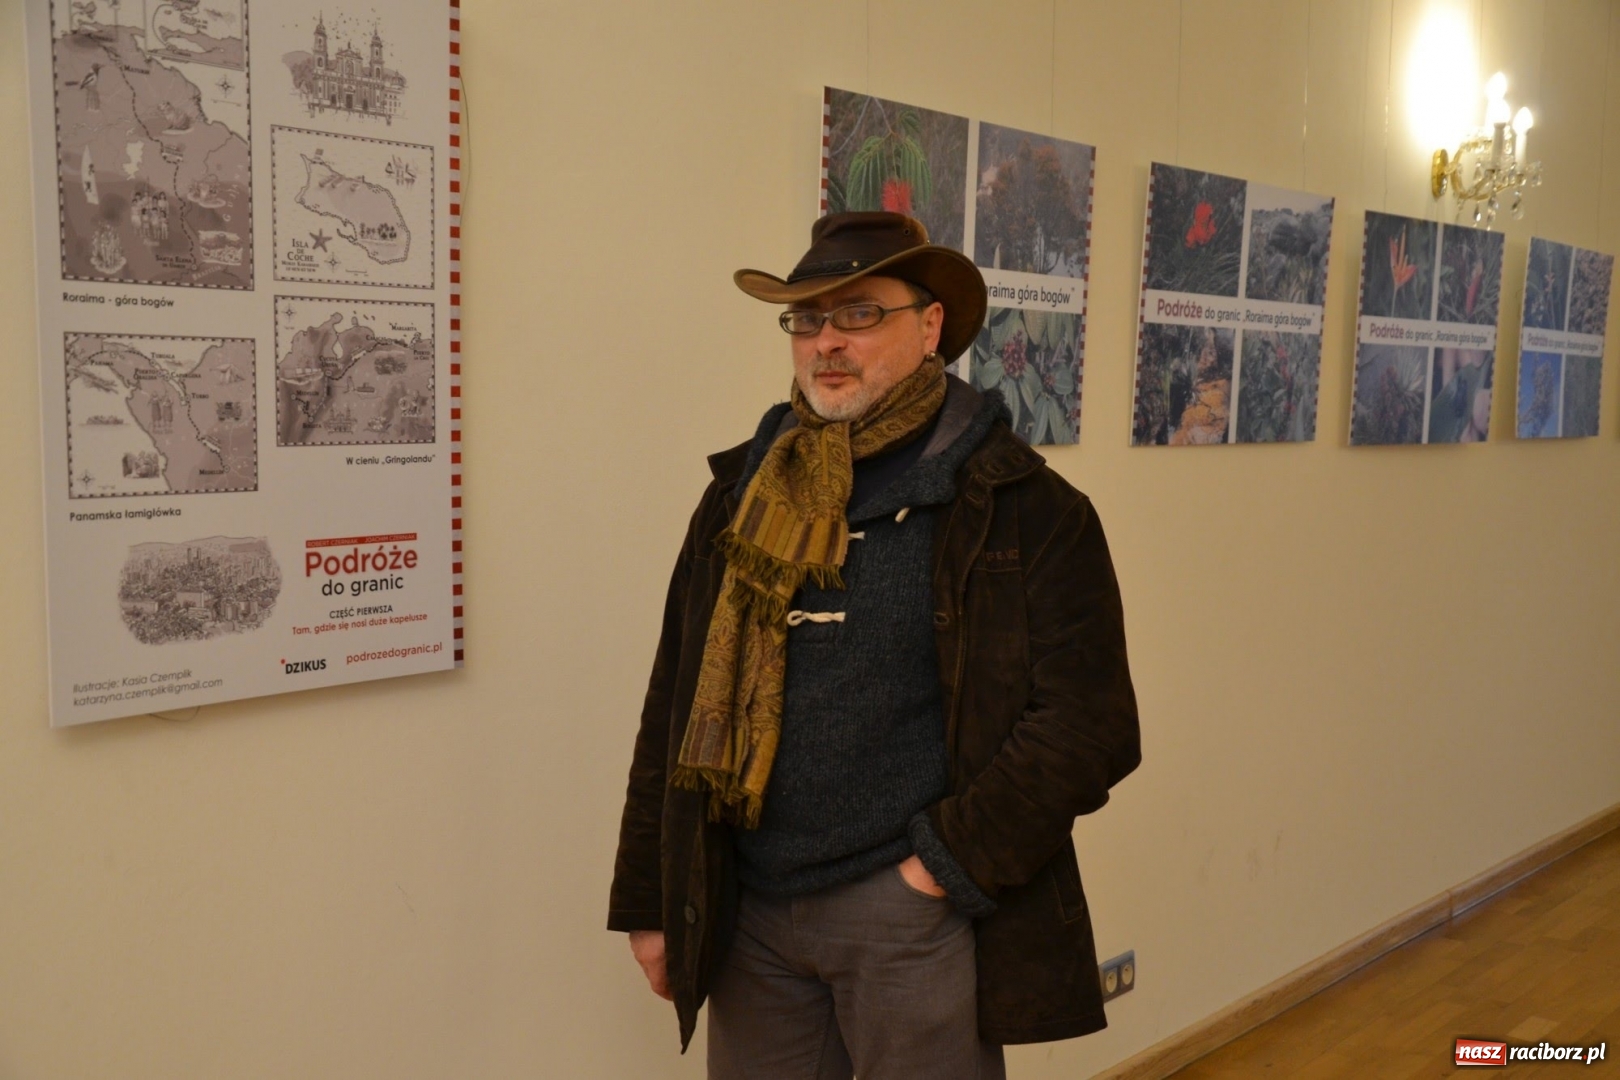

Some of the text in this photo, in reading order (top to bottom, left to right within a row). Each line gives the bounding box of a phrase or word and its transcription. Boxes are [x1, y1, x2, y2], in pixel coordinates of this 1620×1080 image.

[63, 292, 104, 303] Roraima
[115, 295, 138, 306] góra
[141, 294, 174, 307] bogów
[1018, 284, 1038, 304] góra
[1157, 298, 1202, 318] Podróże
[1205, 307, 1215, 319] do
[1218, 309, 1240, 322] granic
[1274, 312, 1289, 328] góra
[1370, 323, 1404, 339] Podróże
[1405, 330, 1413, 339] do
[356, 456, 379, 465] cieniu
[70, 508, 181, 522] Panamska łamigłówka
[306, 545, 418, 577] Podróże
[322, 574, 403, 597] do granic
[329, 605, 393, 619] CZĘŚĆ PIERWSZA
[292, 613, 427, 635] Tam, gdzie się nosi duże kapelusze
[346, 642, 442, 665] podrozedogranic.pl
[286, 659, 326, 674] DZIKUS
[73, 669, 192, 693] Ilustracje: Kasia Czemplik
[73, 678, 223, 706] katarzyna.czemplik@gmail.com
